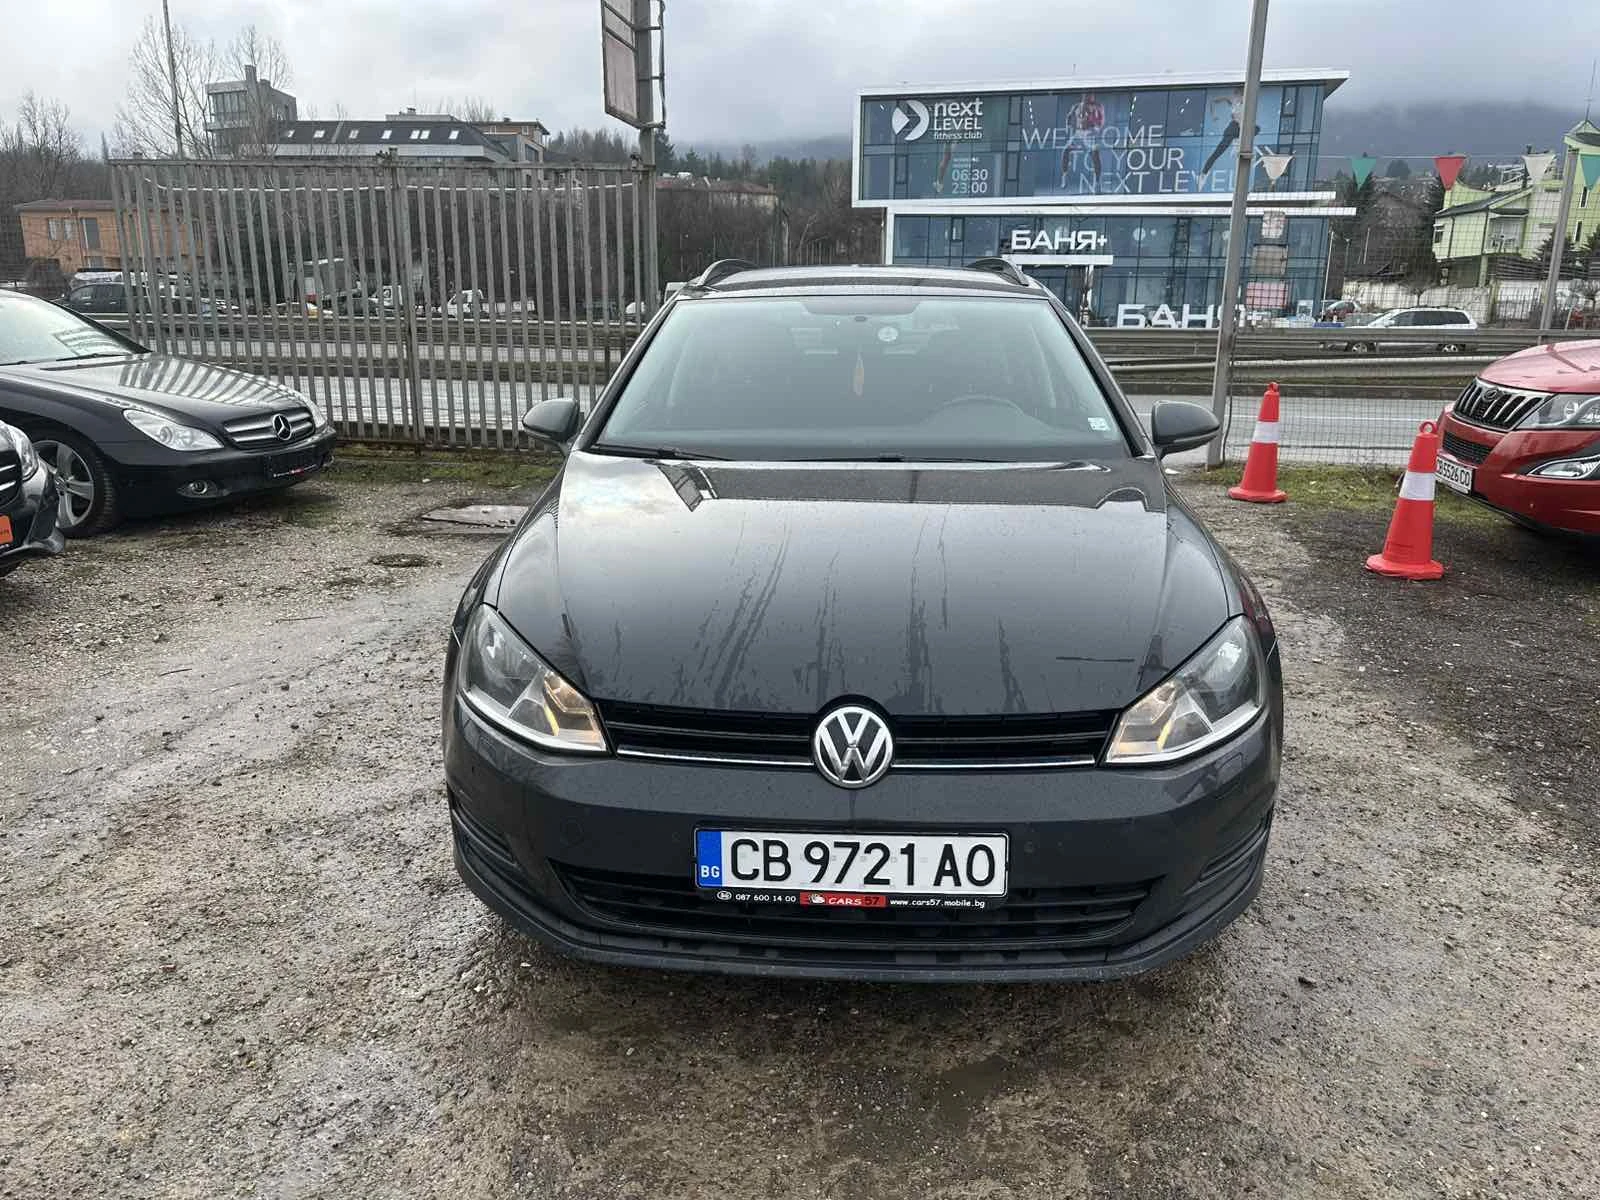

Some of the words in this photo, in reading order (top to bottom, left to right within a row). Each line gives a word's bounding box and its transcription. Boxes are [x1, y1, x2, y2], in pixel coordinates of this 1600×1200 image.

[934, 98, 983, 117] next
[934, 118, 983, 130] LEVEL
[934, 131, 962, 140] fitness
[964, 131, 983, 139] club
[1022, 124, 1164, 150] WELCOME
[1069, 149, 1101, 173] TO
[1111, 147, 1185, 171] YOUR
[951, 169, 988, 181] 06:30
[1079, 170, 1150, 193] NEXT
[951, 182, 988, 194] 23:00
[1011, 229, 1108, 250] БАНЯ+
[701, 865, 720, 878] BG
[730, 838, 792, 882] CB
[804, 841, 915, 886] 9721
[933, 843, 996, 887] AO
[735, 894, 751, 902] 087
[754, 894, 770, 902] 600
[828, 897, 862, 905] CARS
[864, 896, 880, 906] 57
